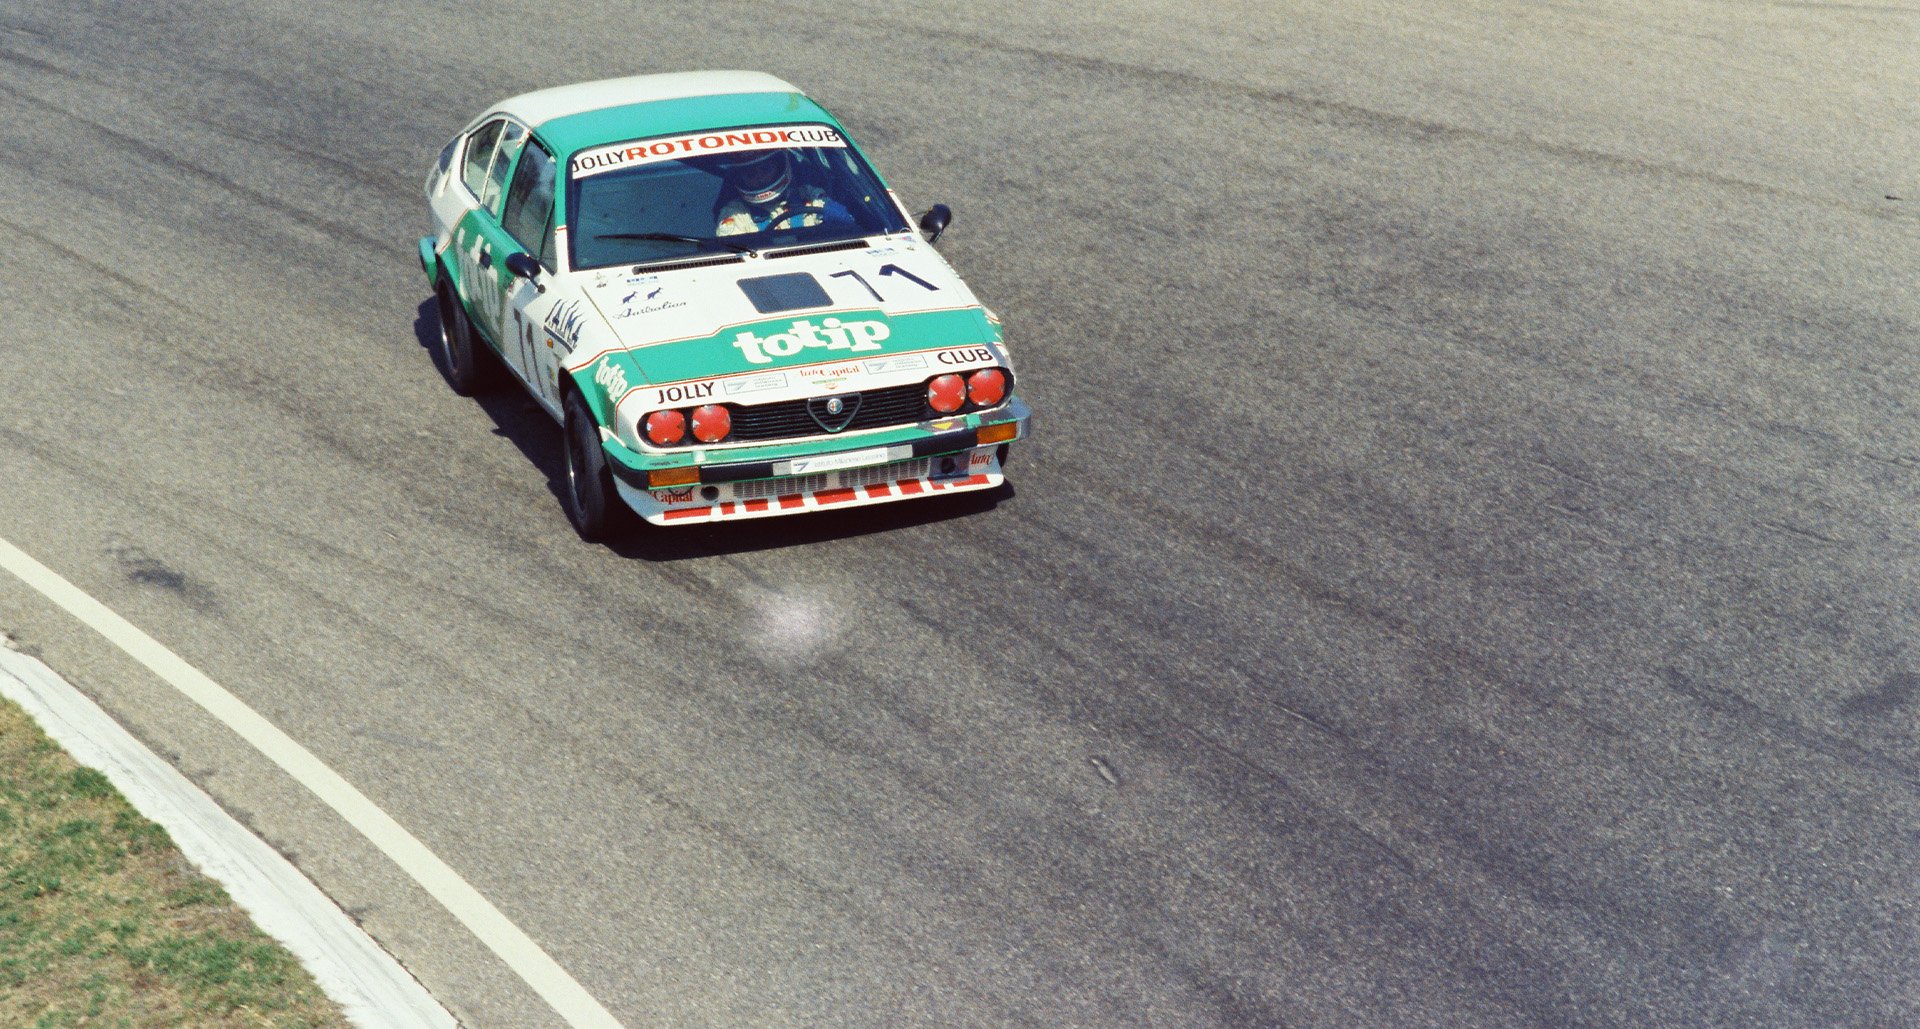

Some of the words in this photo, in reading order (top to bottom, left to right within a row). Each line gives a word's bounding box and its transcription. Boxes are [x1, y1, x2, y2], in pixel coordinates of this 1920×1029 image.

[733, 317, 891, 365] totip
[937, 347, 994, 366] CLUB
[595, 355, 629, 404] totip
[657, 381, 715, 405] JOLLY
